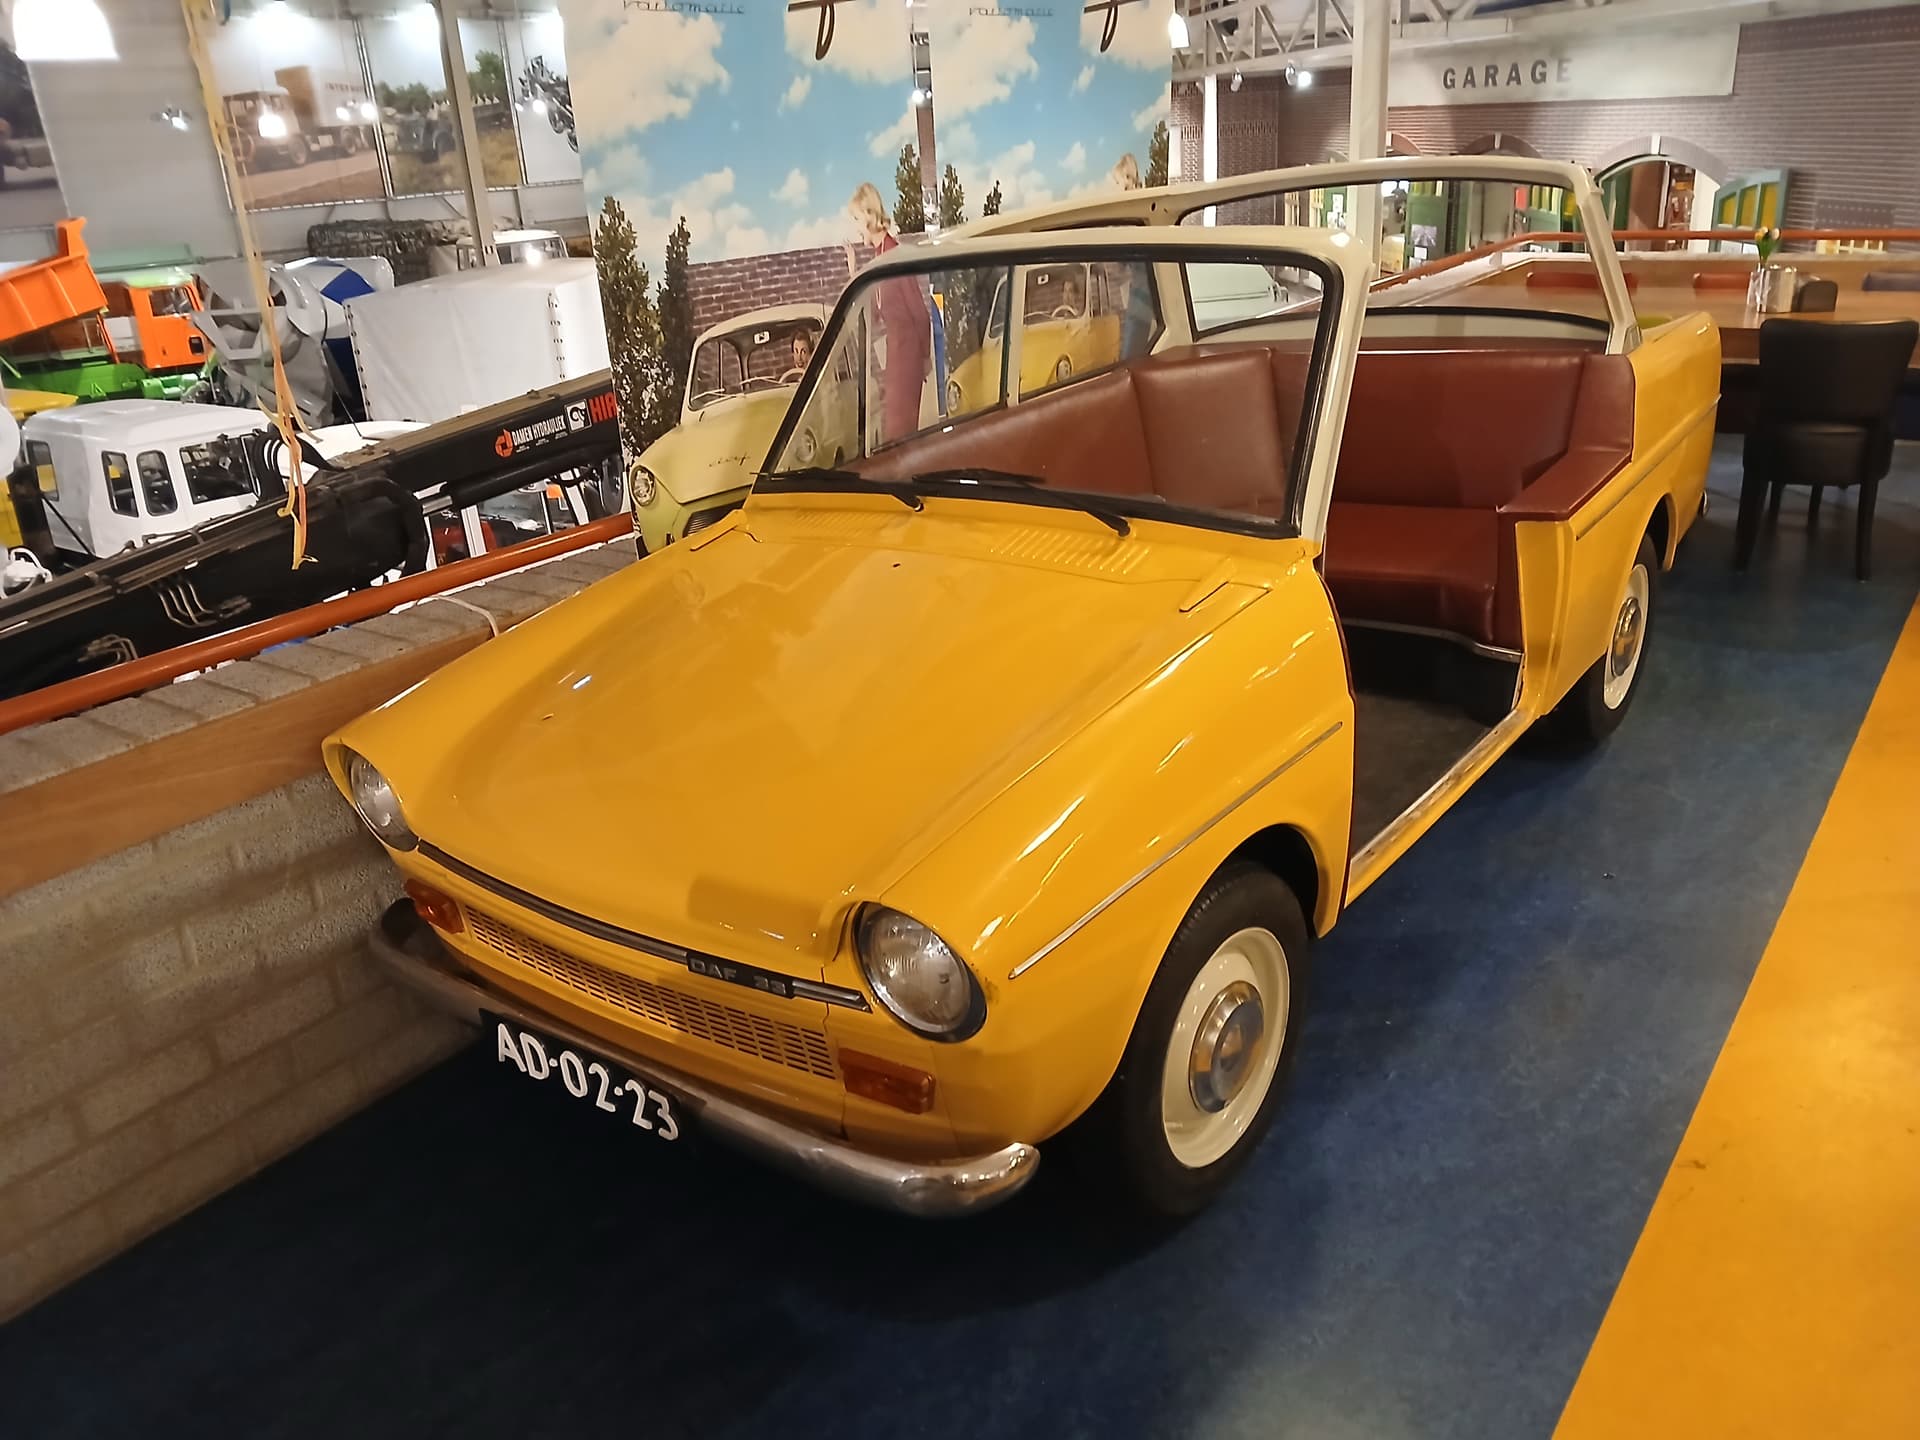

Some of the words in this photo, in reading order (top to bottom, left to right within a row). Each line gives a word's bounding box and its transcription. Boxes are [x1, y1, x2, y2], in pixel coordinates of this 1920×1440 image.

[1442, 58, 1572, 90] GARAGE
[589, 391, 617, 424] HIA
[511, 425, 534, 446] DAMEN
[532, 414, 567, 440] HYDRAULIEK
[690, 958, 737, 981] DAF
